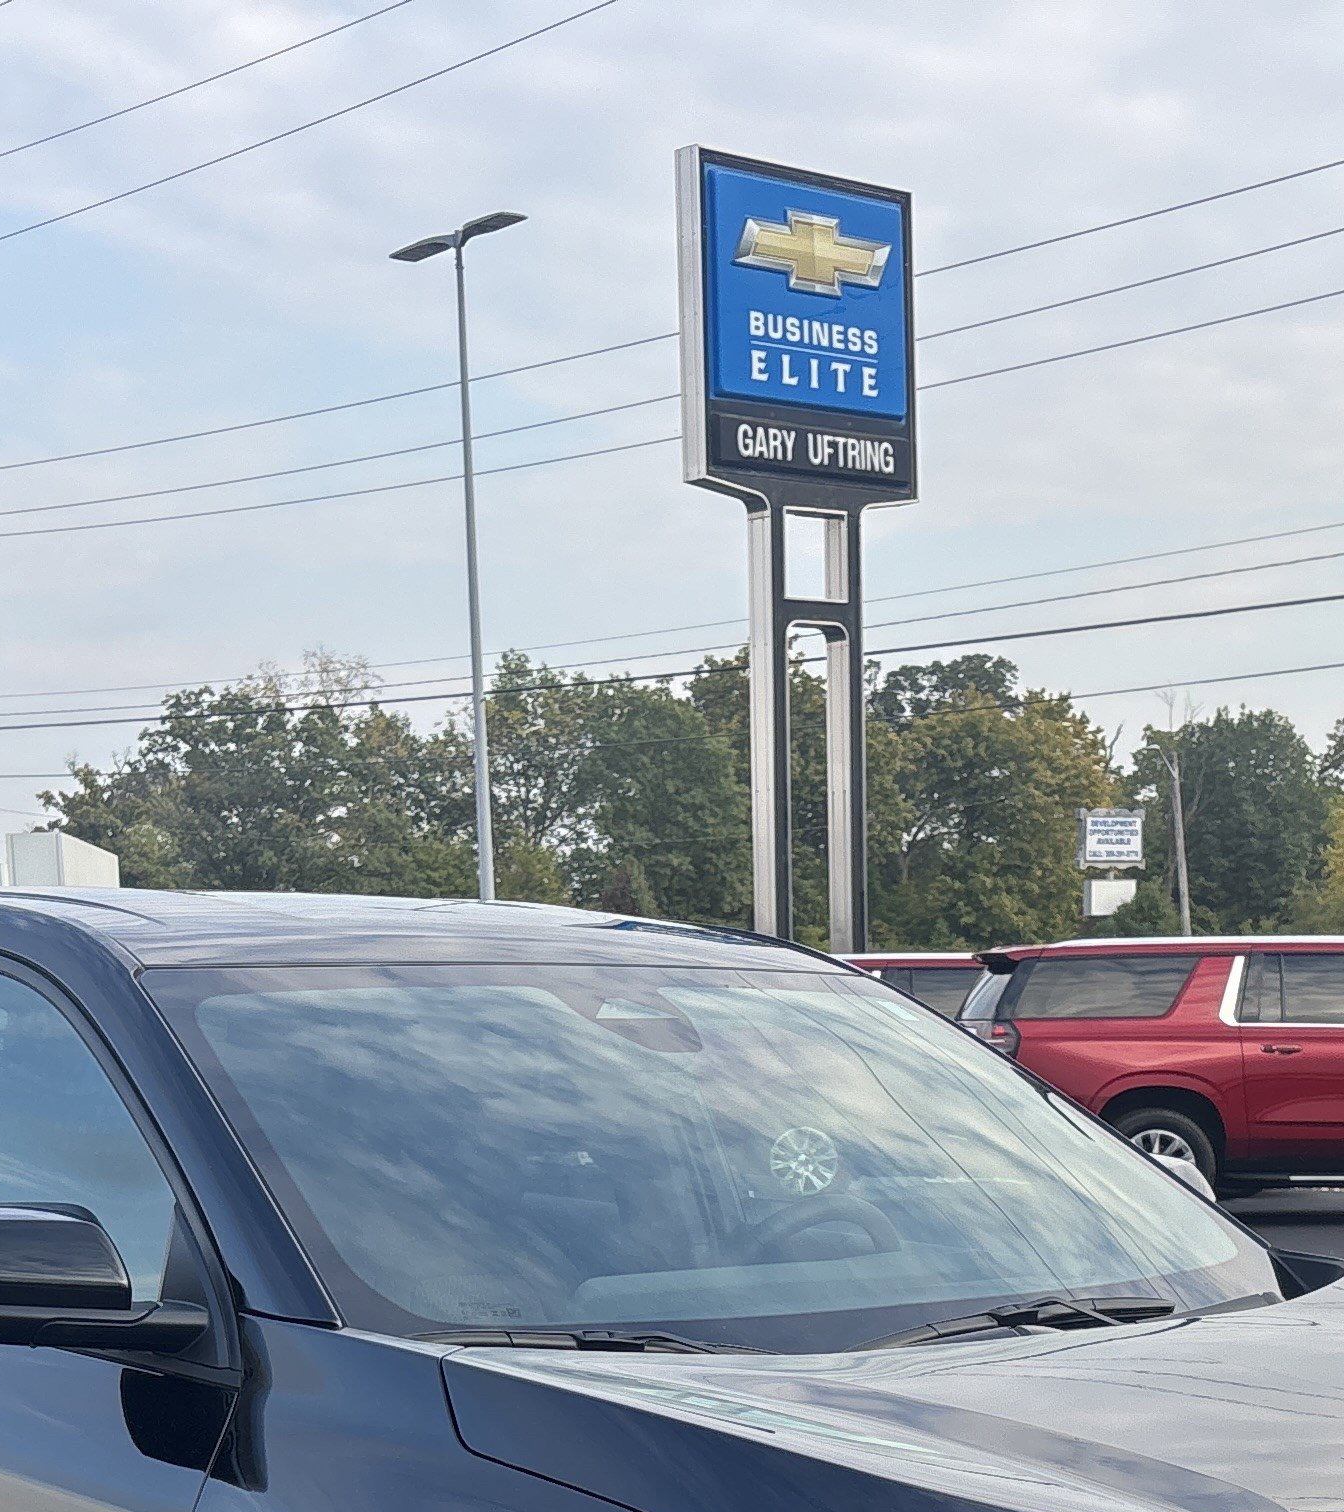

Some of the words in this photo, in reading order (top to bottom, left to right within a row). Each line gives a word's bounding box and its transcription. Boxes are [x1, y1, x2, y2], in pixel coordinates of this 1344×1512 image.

[749, 310, 879, 355] BUSINESS
[750, 349, 879, 398] ELITE
[736, 423, 796, 462] GARY
[807, 433, 895, 475] UFTRING
